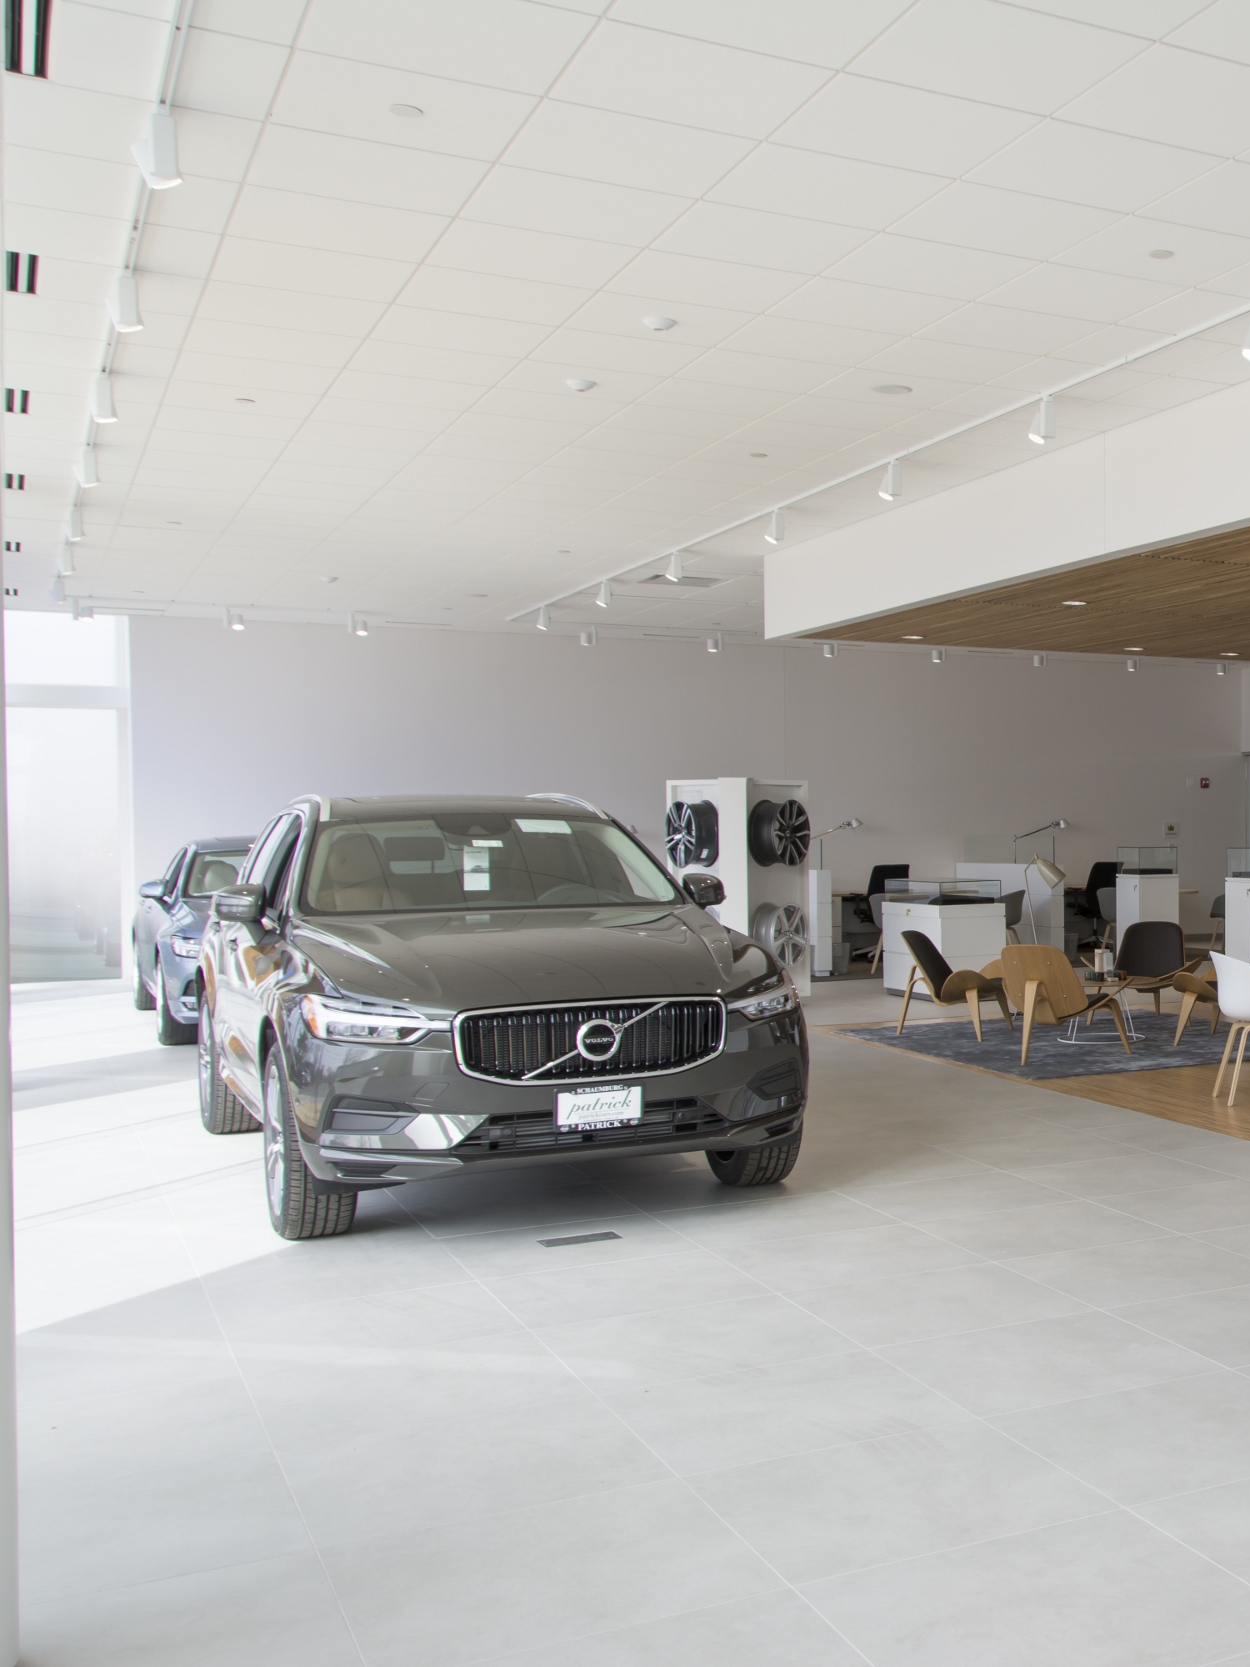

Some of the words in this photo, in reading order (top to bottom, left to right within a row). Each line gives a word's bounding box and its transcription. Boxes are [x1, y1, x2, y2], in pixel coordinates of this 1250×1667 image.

[577, 1085, 623, 1094] SCHAUMBURG
[566, 1090, 631, 1120] patrick
[578, 1120, 621, 1130] PATRICK
